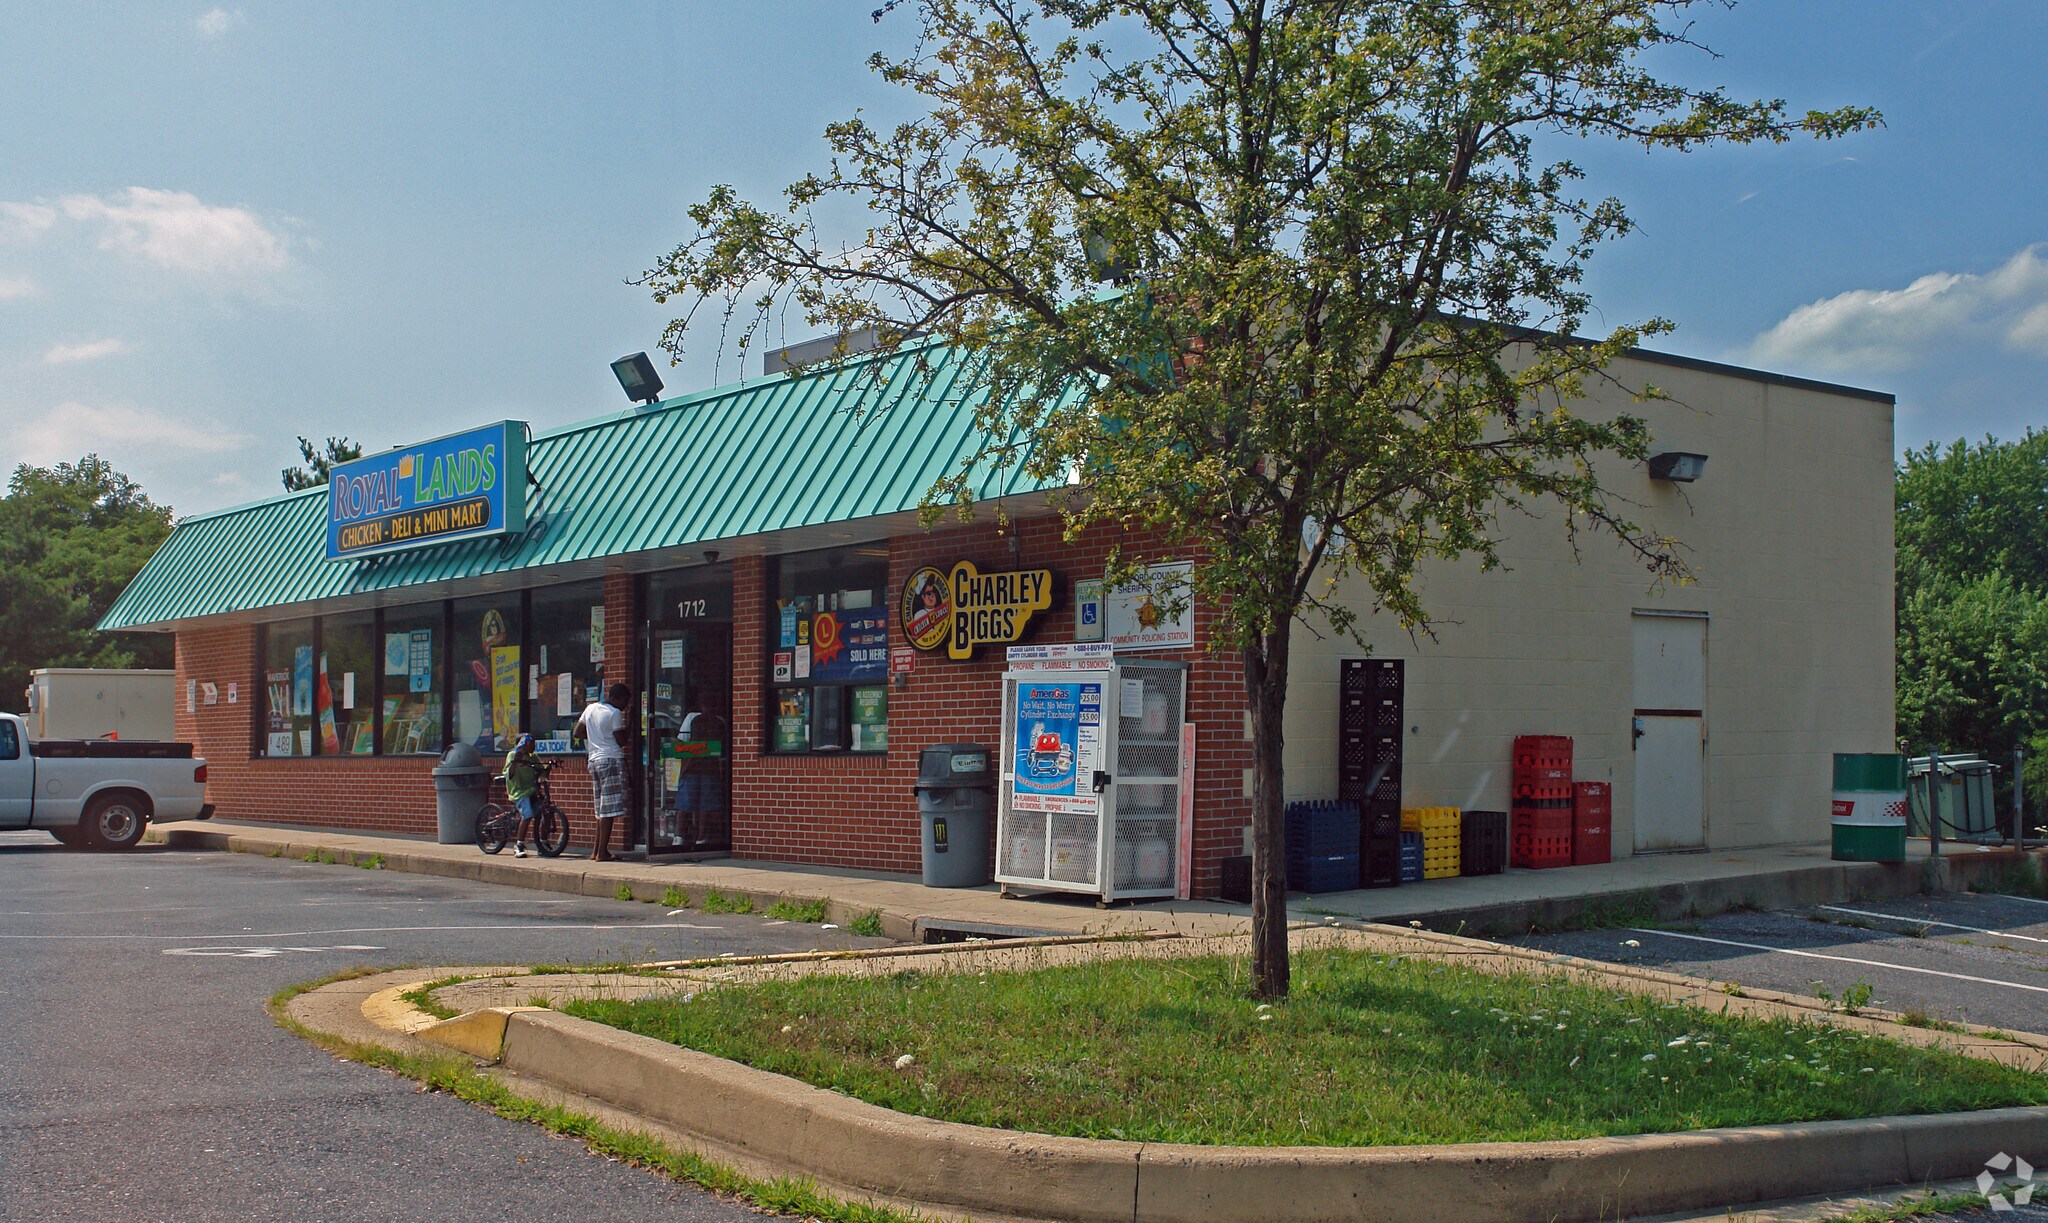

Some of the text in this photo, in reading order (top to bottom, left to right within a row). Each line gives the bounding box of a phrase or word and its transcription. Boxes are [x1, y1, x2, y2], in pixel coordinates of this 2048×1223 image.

[334, 444, 496, 521] ROYAL LANDS
[341, 525, 382, 549] CHICKEN
[392, 518, 411, 538] DELI
[414, 518, 422, 532] &
[423, 509, 448, 531] MINI
[451, 502, 483, 527] MART
[955, 568, 1044, 608] CHARLEY
[678, 599, 706, 618] 1712
[955, 608, 1018, 650] BIGGS'
[1111, 631, 1189, 644] COMMUNITY POLICING STATION
[850, 649, 868, 662] SOLD
[869, 648, 886, 661] HERE
[1013, 659, 1109, 670] PROPANE FLAMMABLE NO SMOKING
[657, 685, 671, 698] OPEN
[1030, 687, 1070, 699] AmeriGas
[1047, 701, 1056, 710] No
[1056, 701, 1076, 711] Worry
[1020, 710, 1076, 721] Cylinder Exchange
[535, 741, 567, 753] USA TODAY
[1045, 803, 1063, 811] PROPANE
